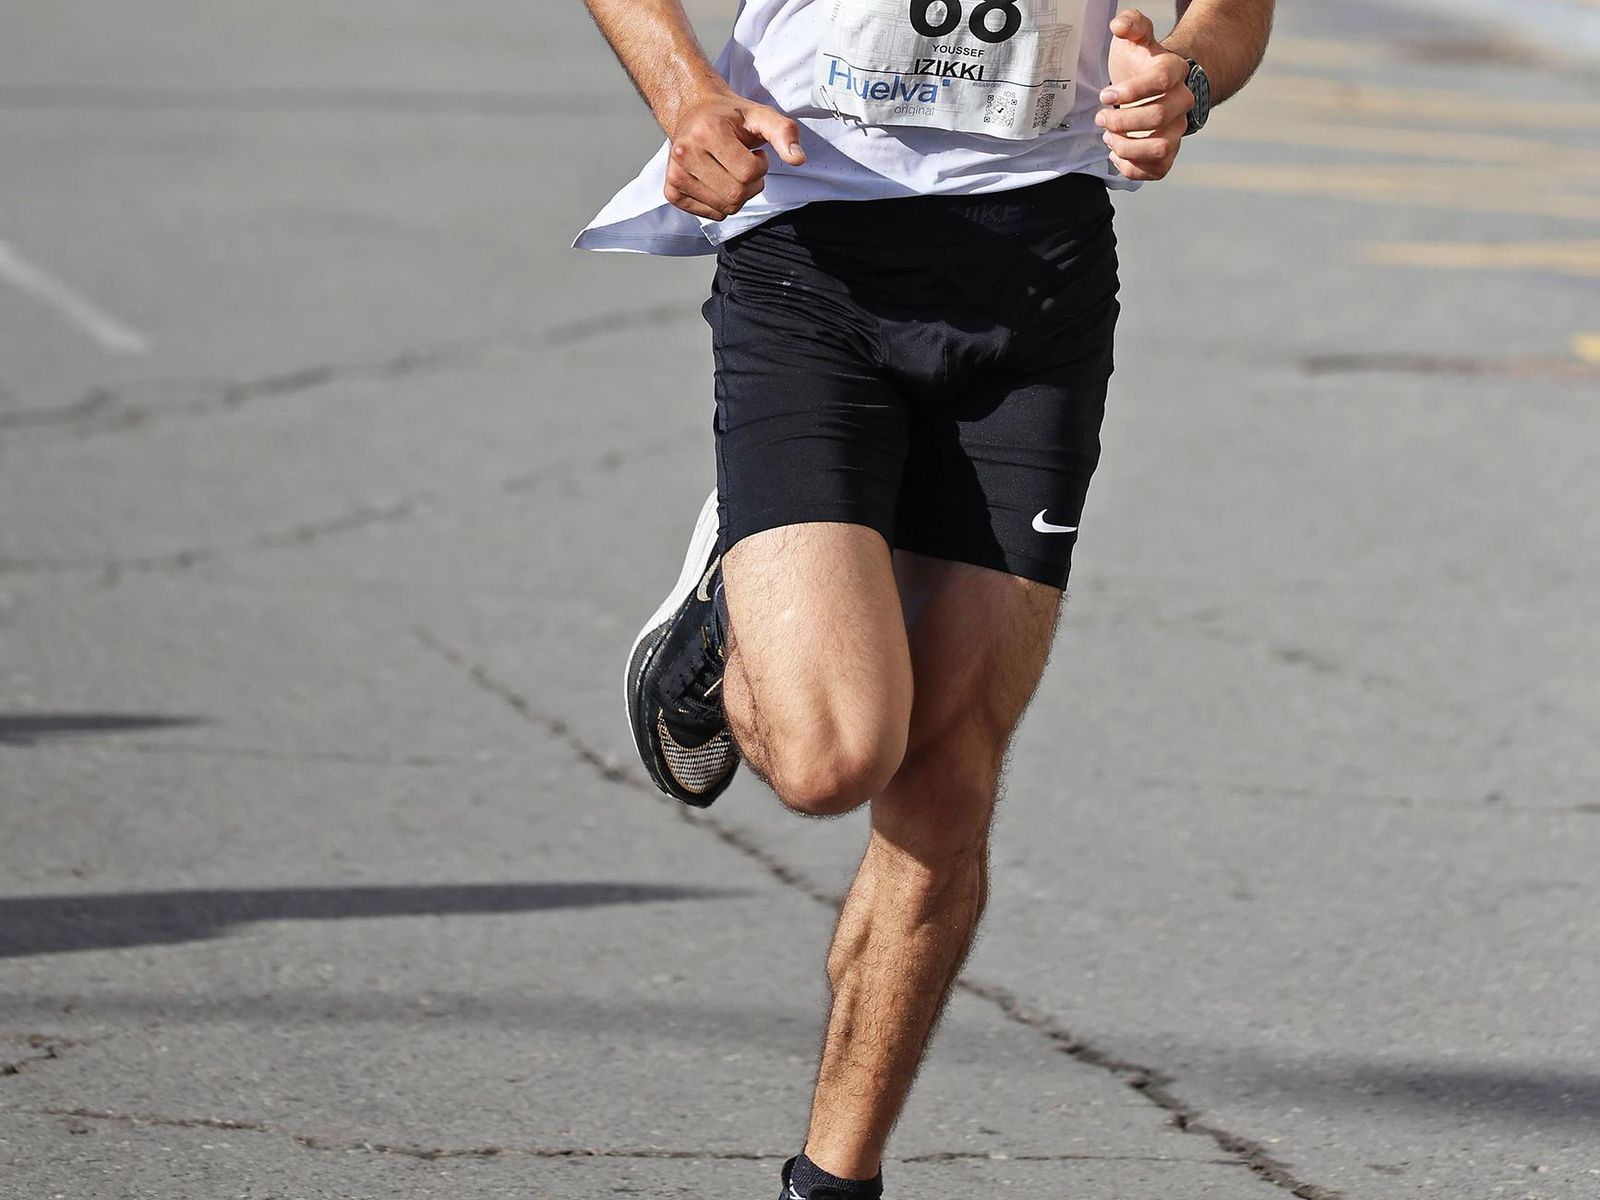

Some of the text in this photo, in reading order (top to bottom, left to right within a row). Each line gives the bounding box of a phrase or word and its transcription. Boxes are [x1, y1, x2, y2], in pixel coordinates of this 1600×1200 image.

[932, 44, 985, 58] YOUSSEF
[914, 58, 985, 82] IZIKKI
[828, 59, 939, 104] Huelva
[894, 104, 936, 117] original
